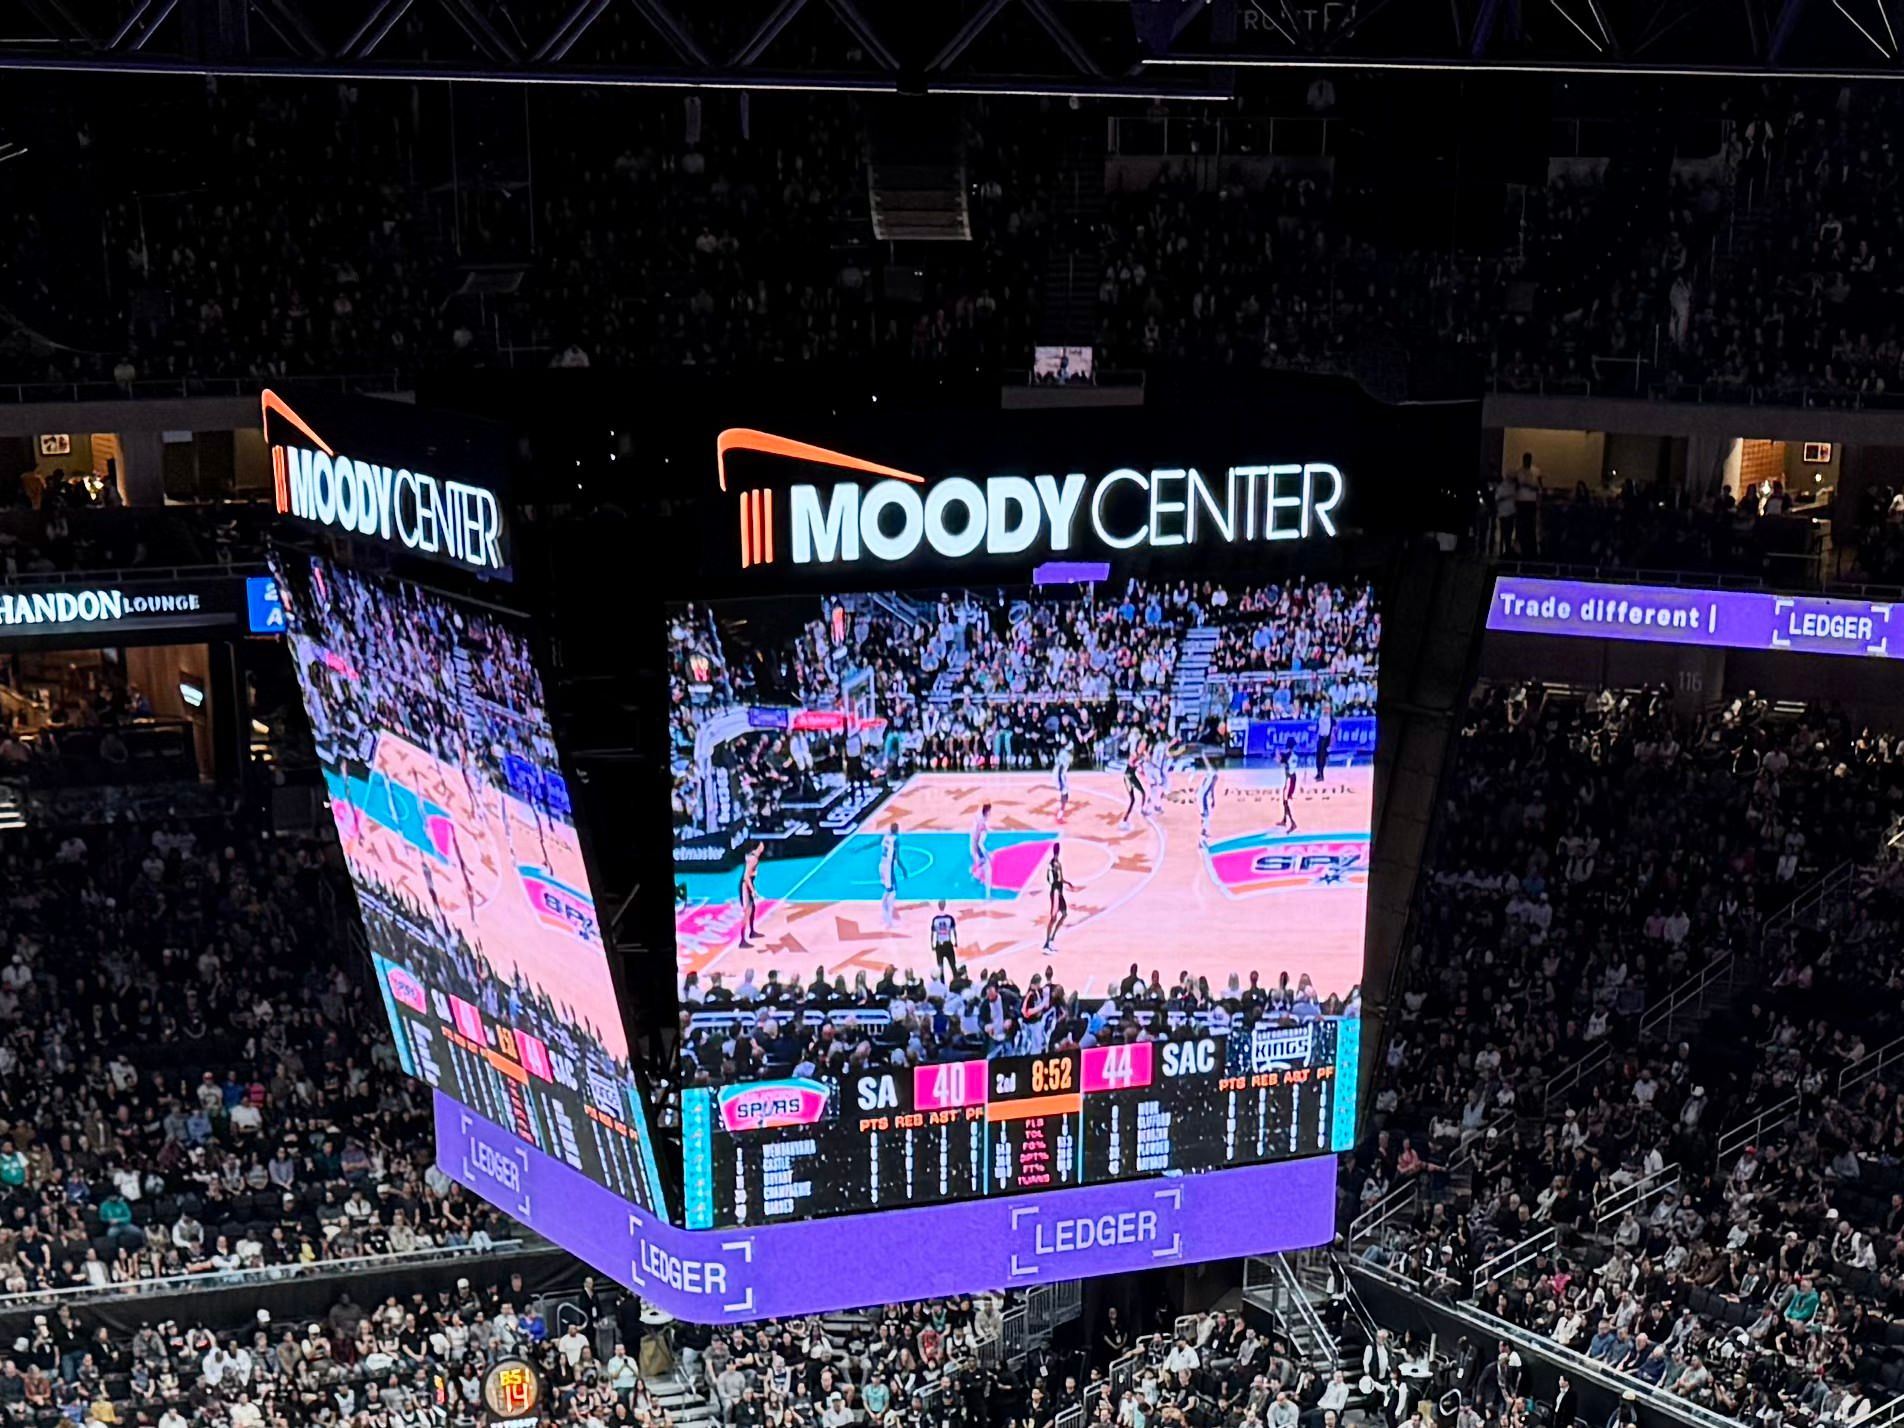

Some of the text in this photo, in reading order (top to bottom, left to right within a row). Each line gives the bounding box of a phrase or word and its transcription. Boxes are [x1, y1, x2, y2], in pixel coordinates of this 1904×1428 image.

[286, 445, 501, 569] MOODY CENTER
[789, 461, 1344, 564] MOODY CENTER
[123, 593, 201, 617] LOUNGE
[1498, 593, 1701, 629] Trade different
[1788, 611, 1875, 641] LEDGER
[1255, 1038, 1309, 1061] KINGS
[856, 1039, 1216, 1111] SA 40 2nd 8:52 44 SAC
[1219, 1078, 1246, 1092] PTS
[1251, 1074, 1279, 1088] REB
[1316, 1066, 1334, 1080] PF
[737, 1098, 801, 1119] SPURS
[859, 1106, 984, 1133] PTS REB AST PF
[470, 1136, 521, 1193] LEDGER
[1034, 1210, 1159, 1257] LEDGER
[640, 1238, 727, 1295] LEDGER
